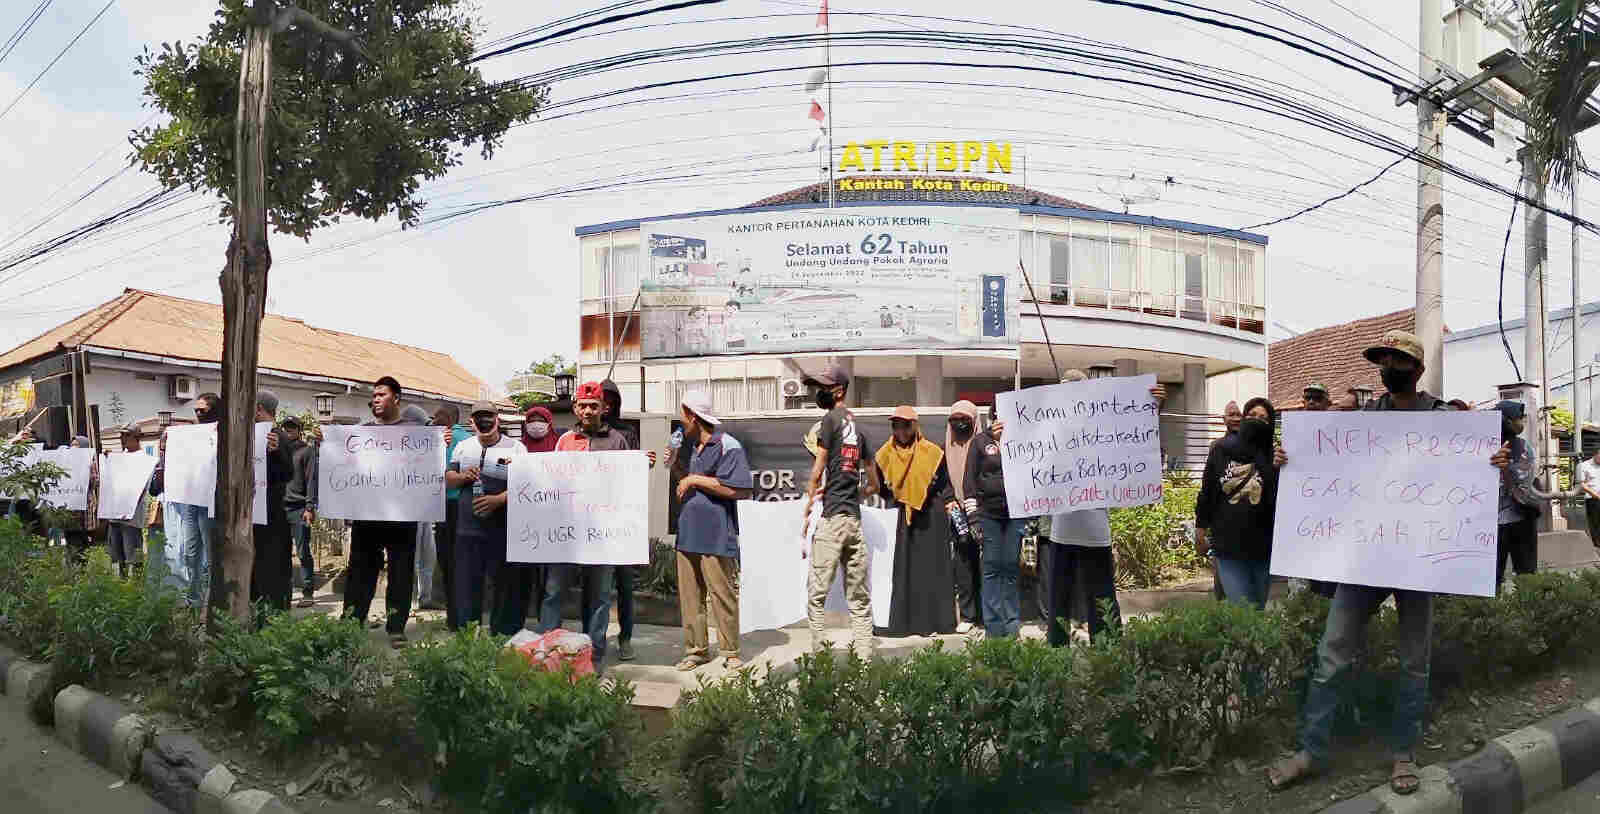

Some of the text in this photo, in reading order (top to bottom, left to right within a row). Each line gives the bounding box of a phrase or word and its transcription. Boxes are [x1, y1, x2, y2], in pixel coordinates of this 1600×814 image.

[839, 178, 1009, 193] Kantah Kota Kediri
[727, 216, 931, 233] KANTOR PERTANAHAN KOTA KEDIRI
[786, 233, 949, 257] Selamat 62 Tahun
[1015, 400, 1067, 425] Kami
[1031, 464, 1073, 488] Kota
